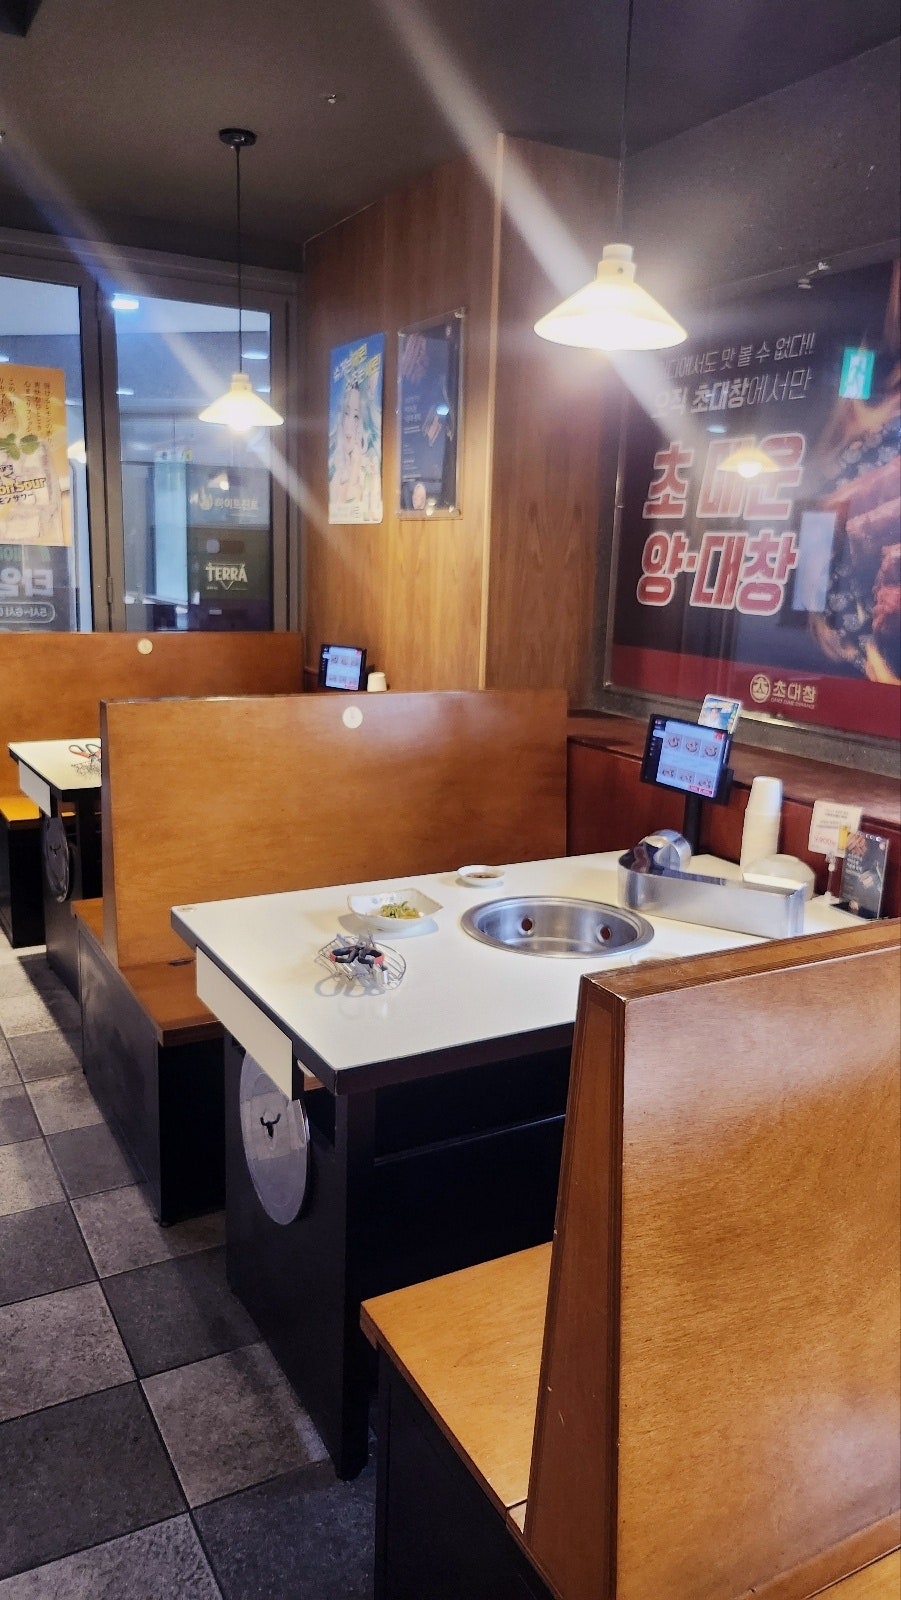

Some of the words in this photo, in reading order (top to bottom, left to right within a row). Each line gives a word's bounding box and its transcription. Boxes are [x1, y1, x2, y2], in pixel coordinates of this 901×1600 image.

[720, 347, 737, 370] 맛
[737, 344, 754, 368] 볼
[755, 340, 771, 364] 수
[773, 331, 816, 361] 없다!!
[690, 366, 813, 413] 초대창에서만
[15, 477, 46, 493] Sour
[642, 441, 694, 519] 초
[696, 433, 806, 520] 매운
[205, 562, 248, 583] TERRA
[772, 679, 816, 703] 초대창
